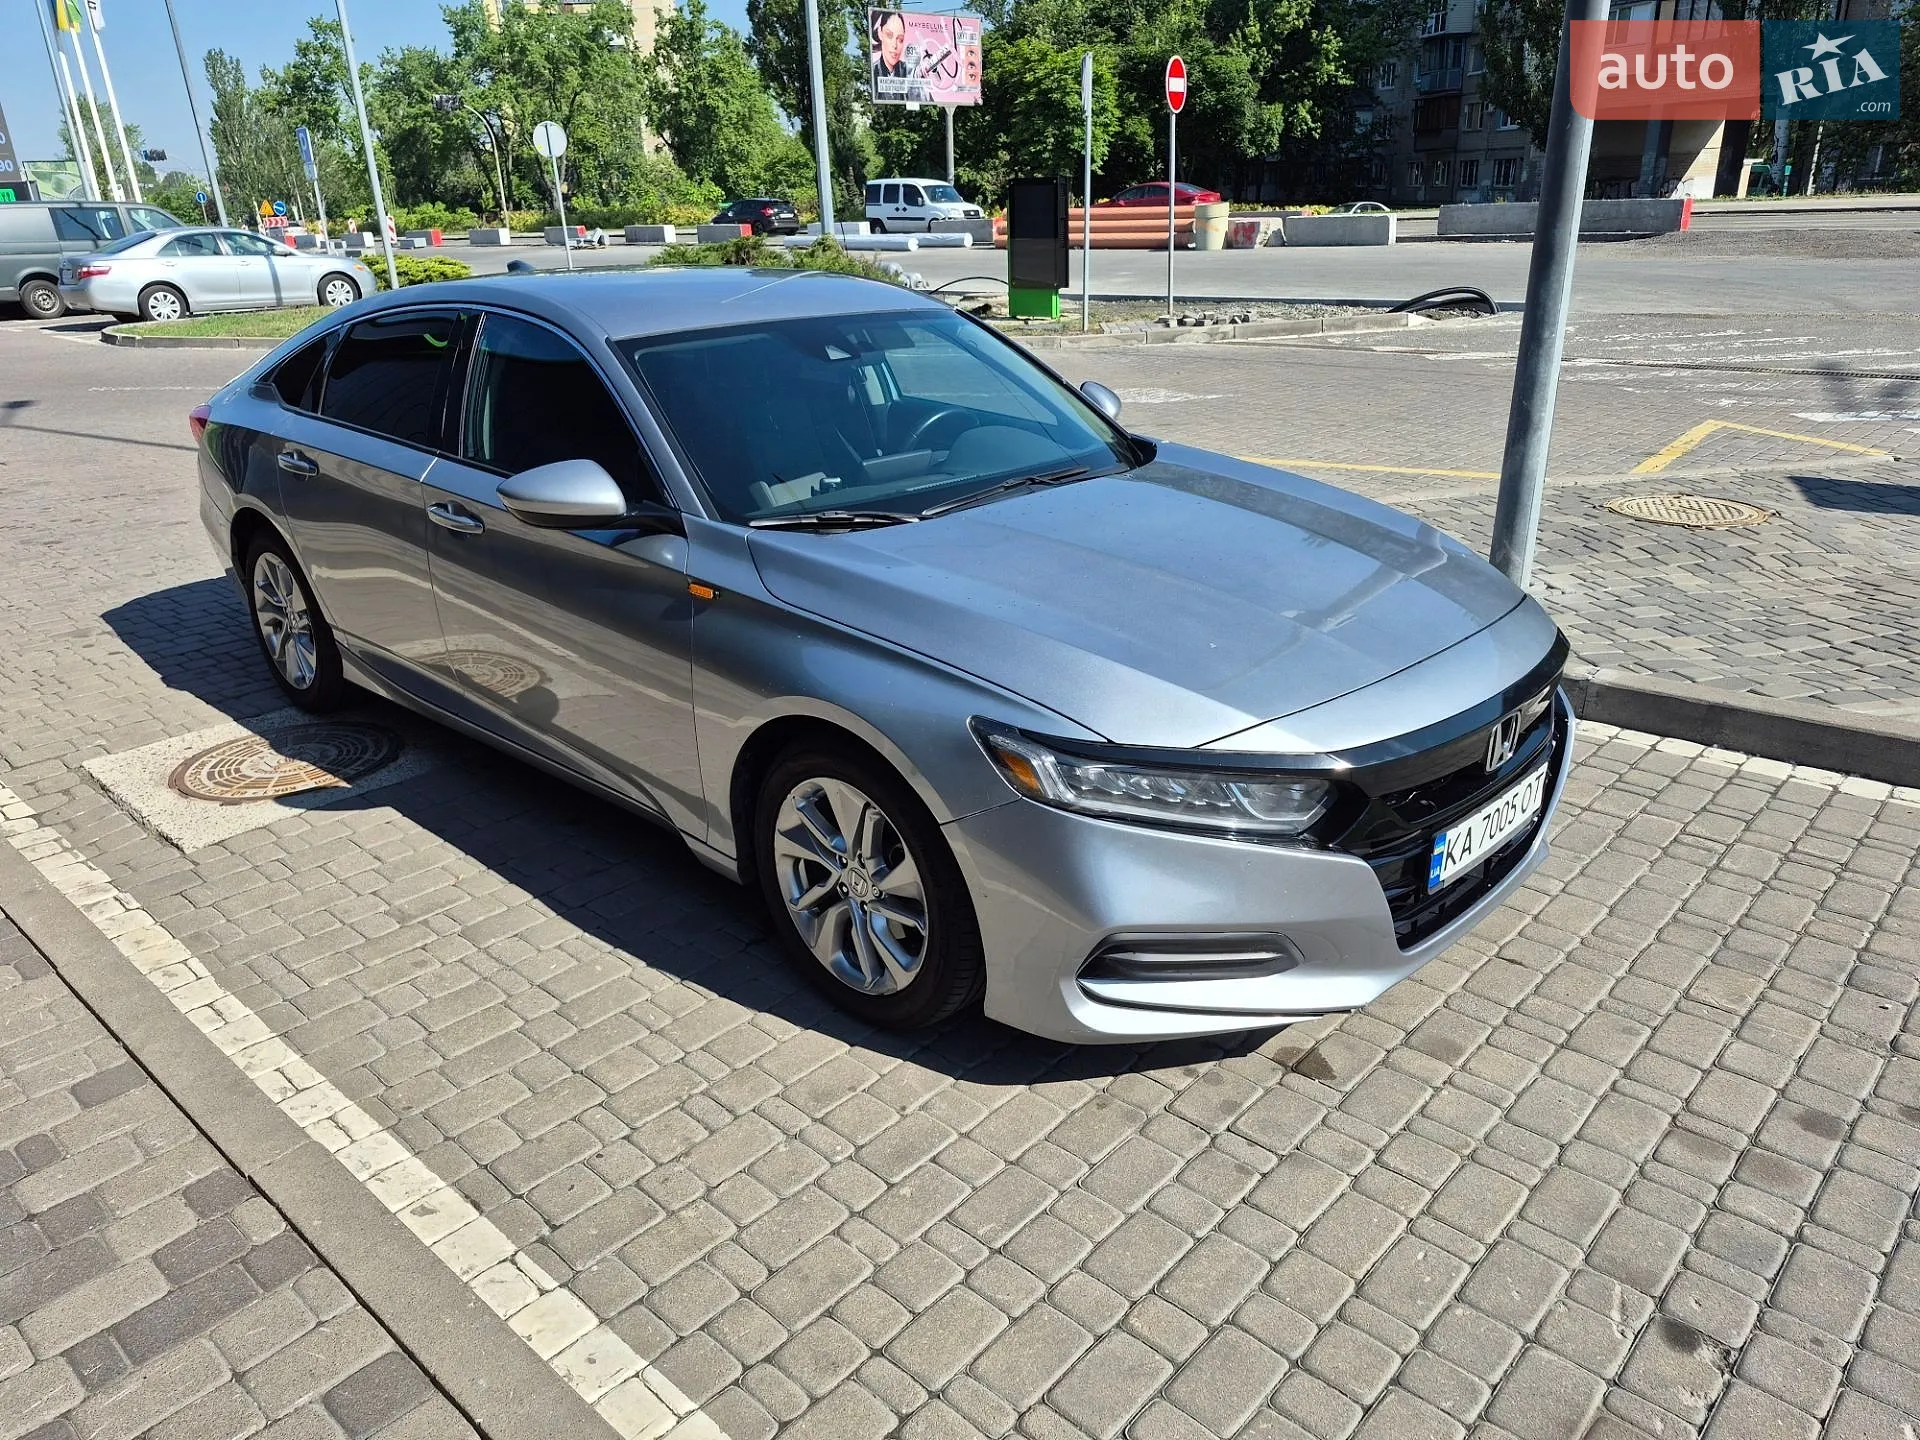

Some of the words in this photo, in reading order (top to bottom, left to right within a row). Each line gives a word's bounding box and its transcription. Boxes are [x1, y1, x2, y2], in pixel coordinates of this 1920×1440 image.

[908, 21, 949, 31] MAYBELLINE
[1444, 826, 1472, 871] KA
[1479, 792, 1518, 849] 7005
[1521, 771, 1544, 814] OT
